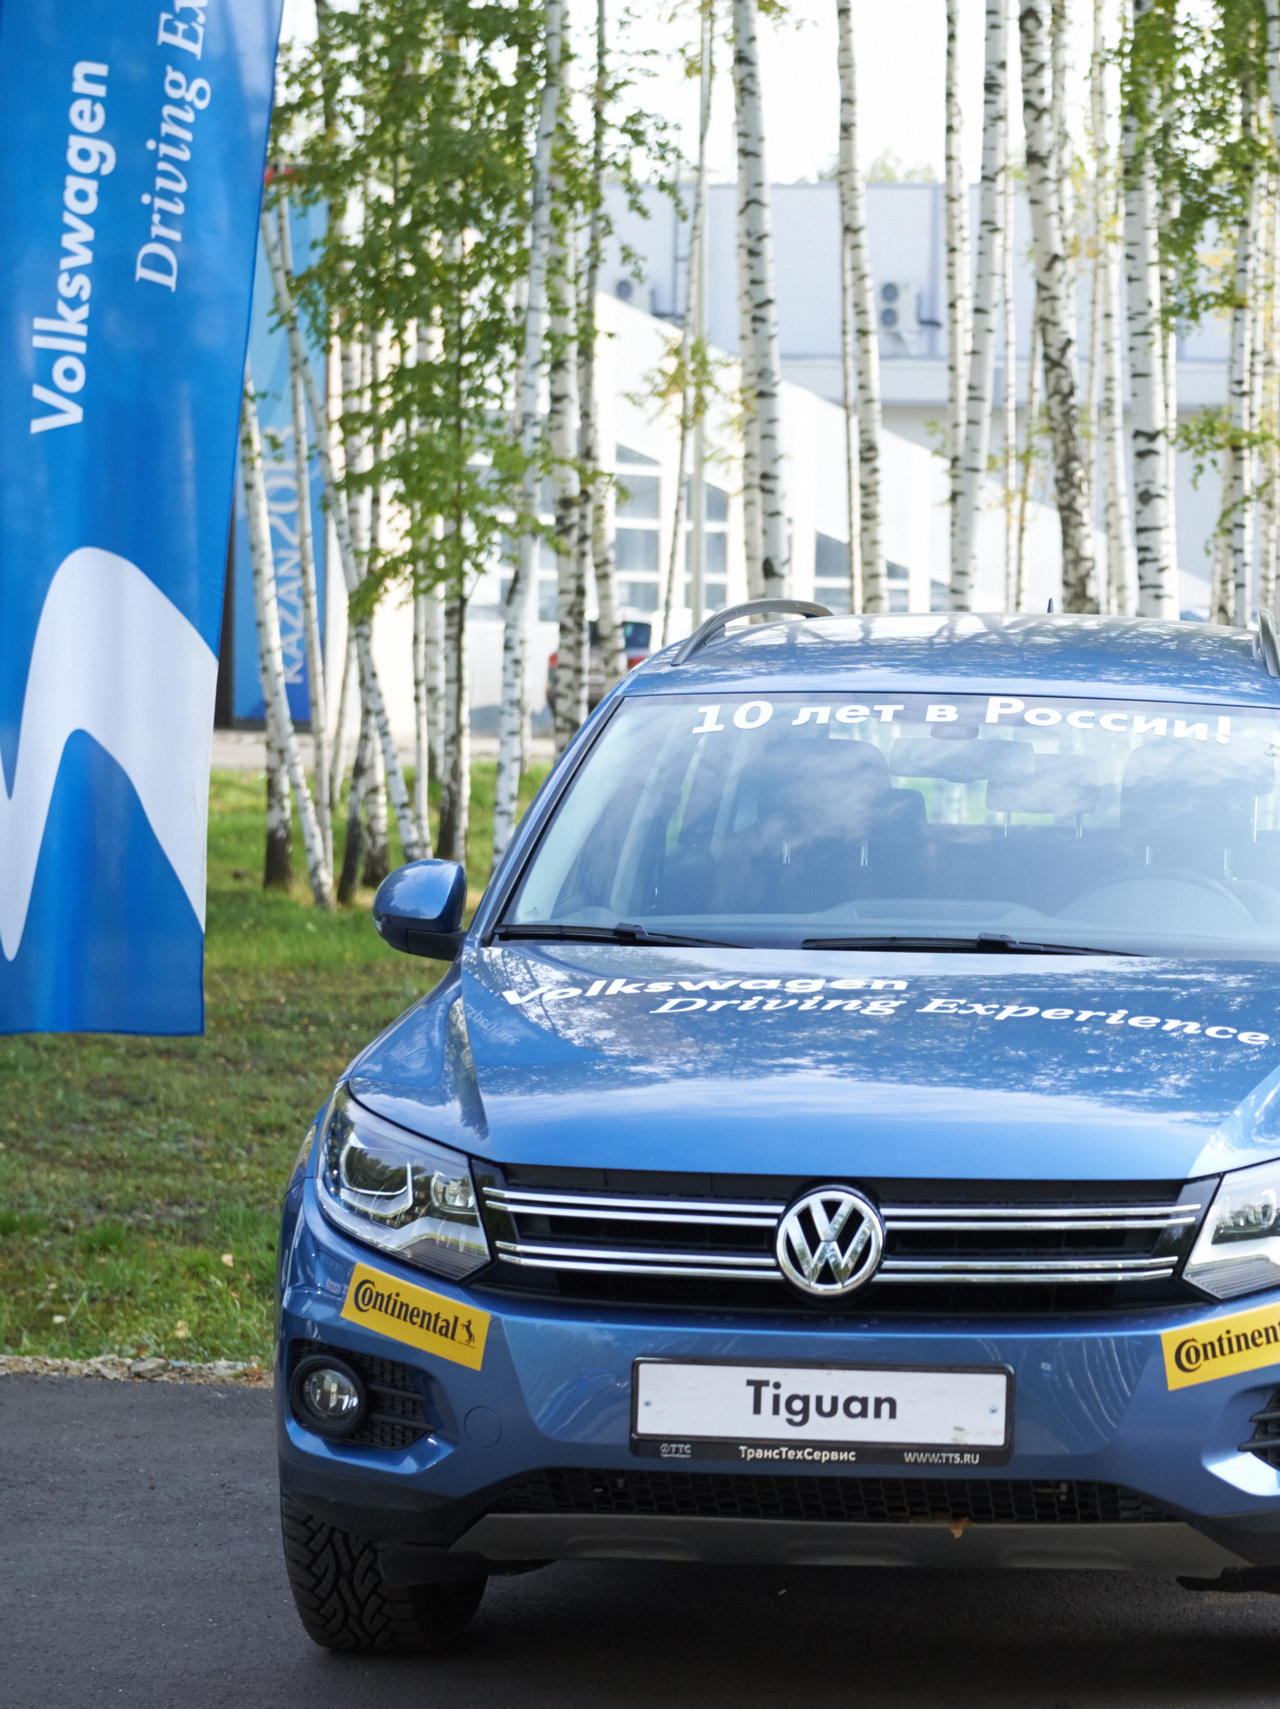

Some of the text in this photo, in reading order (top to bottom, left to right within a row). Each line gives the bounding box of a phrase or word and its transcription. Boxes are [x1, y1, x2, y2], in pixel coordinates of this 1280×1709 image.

[135, 64, 211, 293] Driving
[30, 61, 116, 434] Volkswagen
[691, 697, 1232, 745] 10 лет в России!
[501, 978, 909, 1004] Volkswagen
[649, 997, 1271, 1046] Driving Experience
[354, 1279, 459, 1341] Continental
[746, 1379, 897, 1427] Tiguan
[739, 1446, 856, 1462] ТрансТехСервис
[904, 1452, 980, 1465] WWW.TTS.RU
